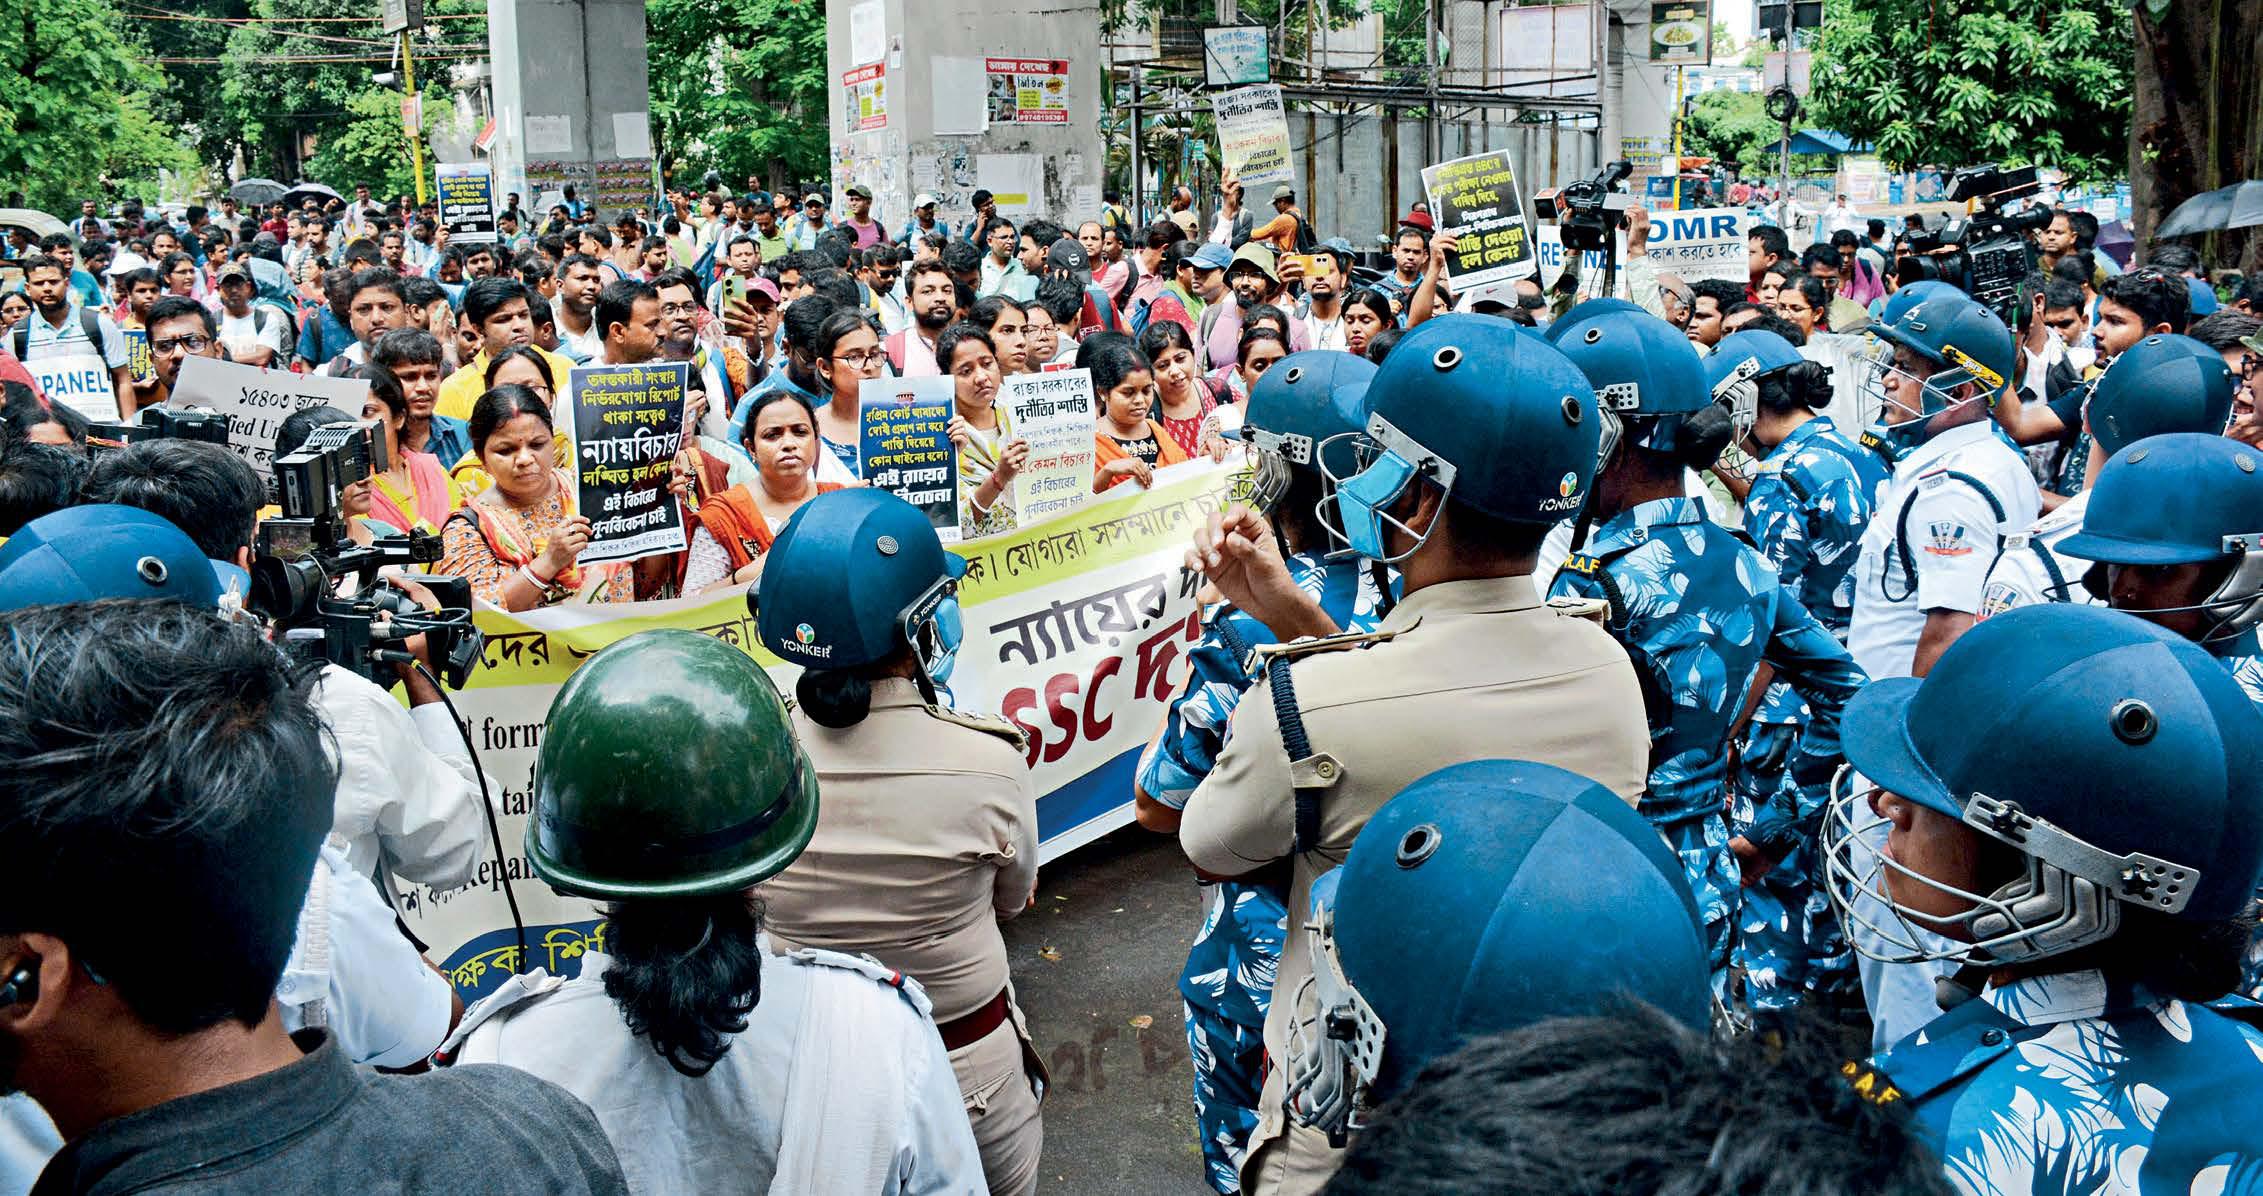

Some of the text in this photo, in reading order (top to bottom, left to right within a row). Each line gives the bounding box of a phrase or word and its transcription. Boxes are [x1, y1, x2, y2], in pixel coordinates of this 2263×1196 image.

[1647, 215, 1740, 243] OMR
[1459, 245, 1519, 269] হল কেন?
[40, 371, 109, 397] PANEL
[648, 385, 680, 403] রিপোর্ট
[1041, 377, 1088, 394] সরকারের
[239, 386, 290, 409] ১৫৪০৩
[1056, 394, 1088, 414] শাস্তি
[603, 410, 633, 425] থাকা
[581, 427, 680, 464] ন্যায়বিচার
[632, 466, 649, 481] হল
[1028, 457, 1058, 473] কেমন
[872, 466, 948, 487] এই রায়ের
[603, 487, 658, 511] এই বিচারের
[1030, 480, 1042, 496] এই
[1538, 490, 1584, 511] YONKER
[648, 505, 667, 526] চাই
[482, 632, 549, 667] দের
[1005, 527, 1087, 577] যোগ্যরা
[1088, 499, 1188, 547] সসম্মানে
[990, 573, 1167, 666] ন্যায়ের
[781, 637, 831, 659] YONKER
[1001, 655, 1125, 769] SSC
[482, 716, 546, 750] form
[442, 945, 528, 990] ক্ষক
